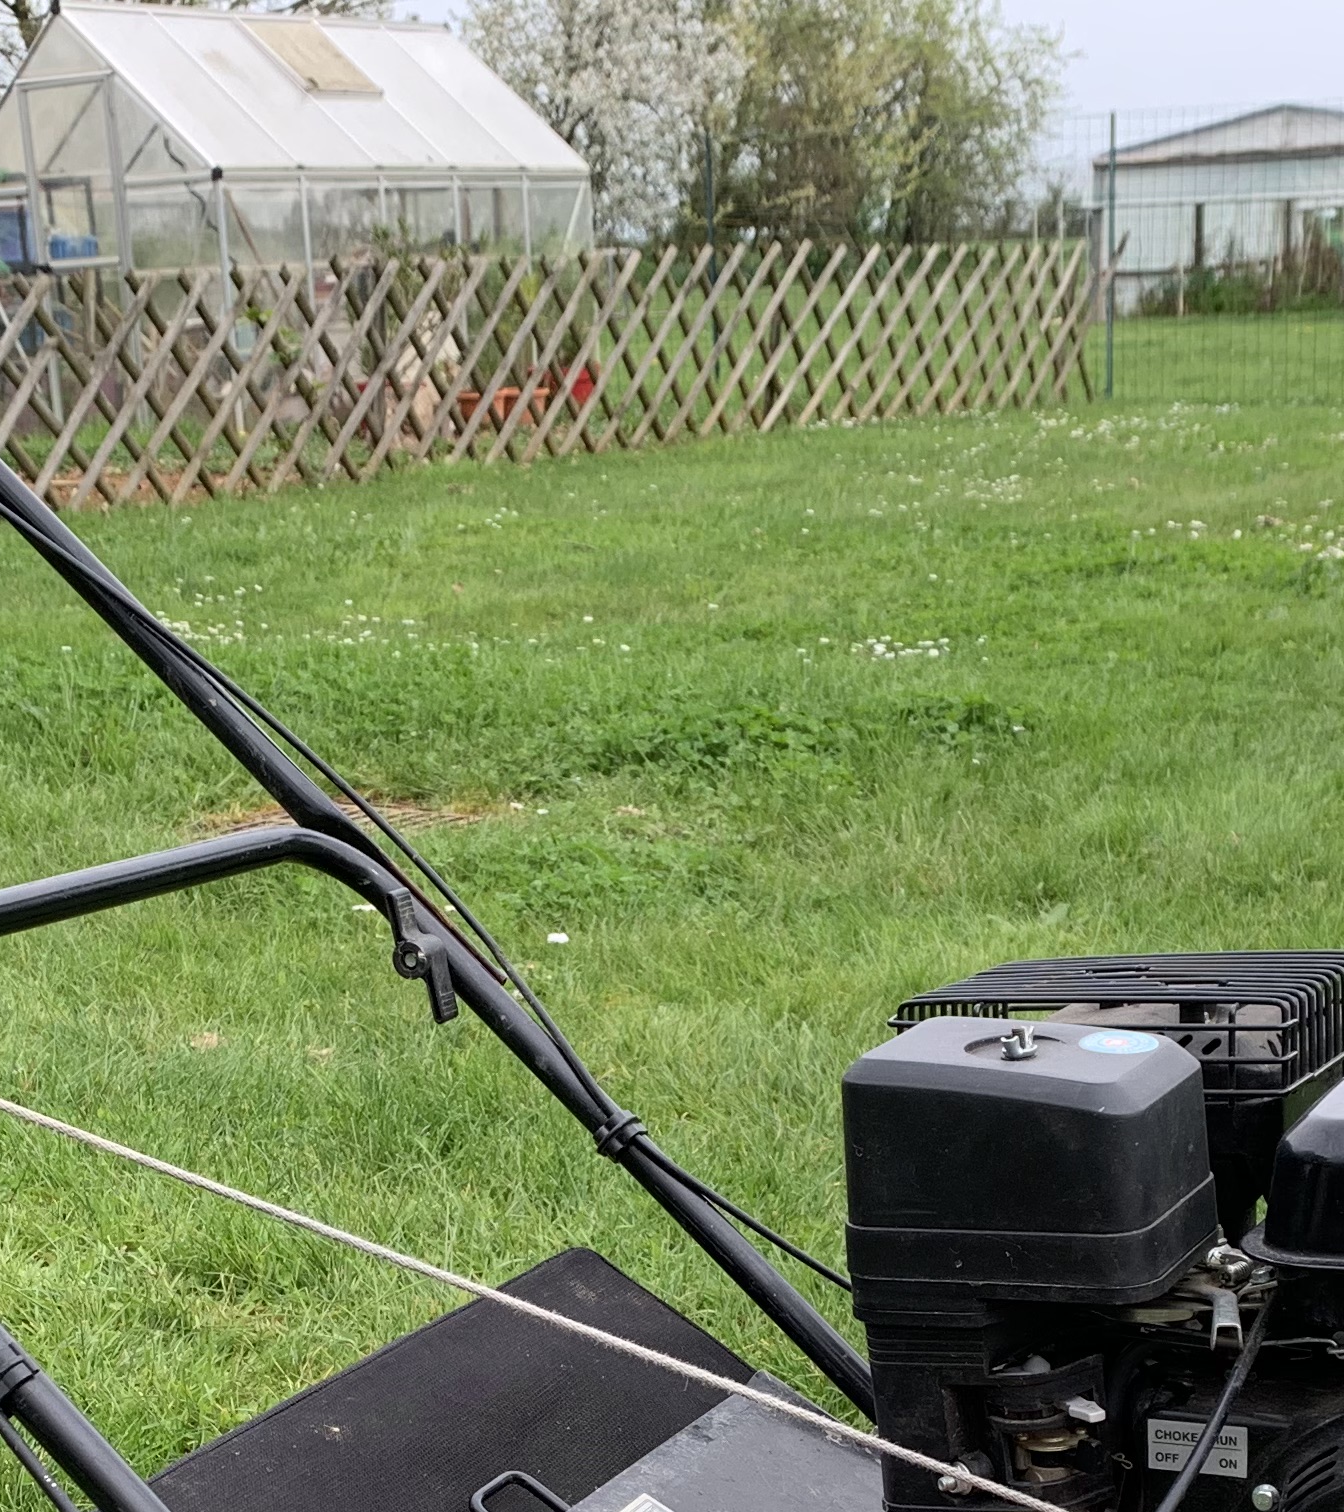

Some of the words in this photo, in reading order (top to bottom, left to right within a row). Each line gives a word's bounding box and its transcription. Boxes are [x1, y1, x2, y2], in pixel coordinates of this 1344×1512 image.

[1154, 1429, 1199, 1443] CHOKE
[1215, 1435, 1238, 1446] UN
[1155, 1451, 1179, 1464] OFF
[1219, 1458, 1238, 1469] ON
